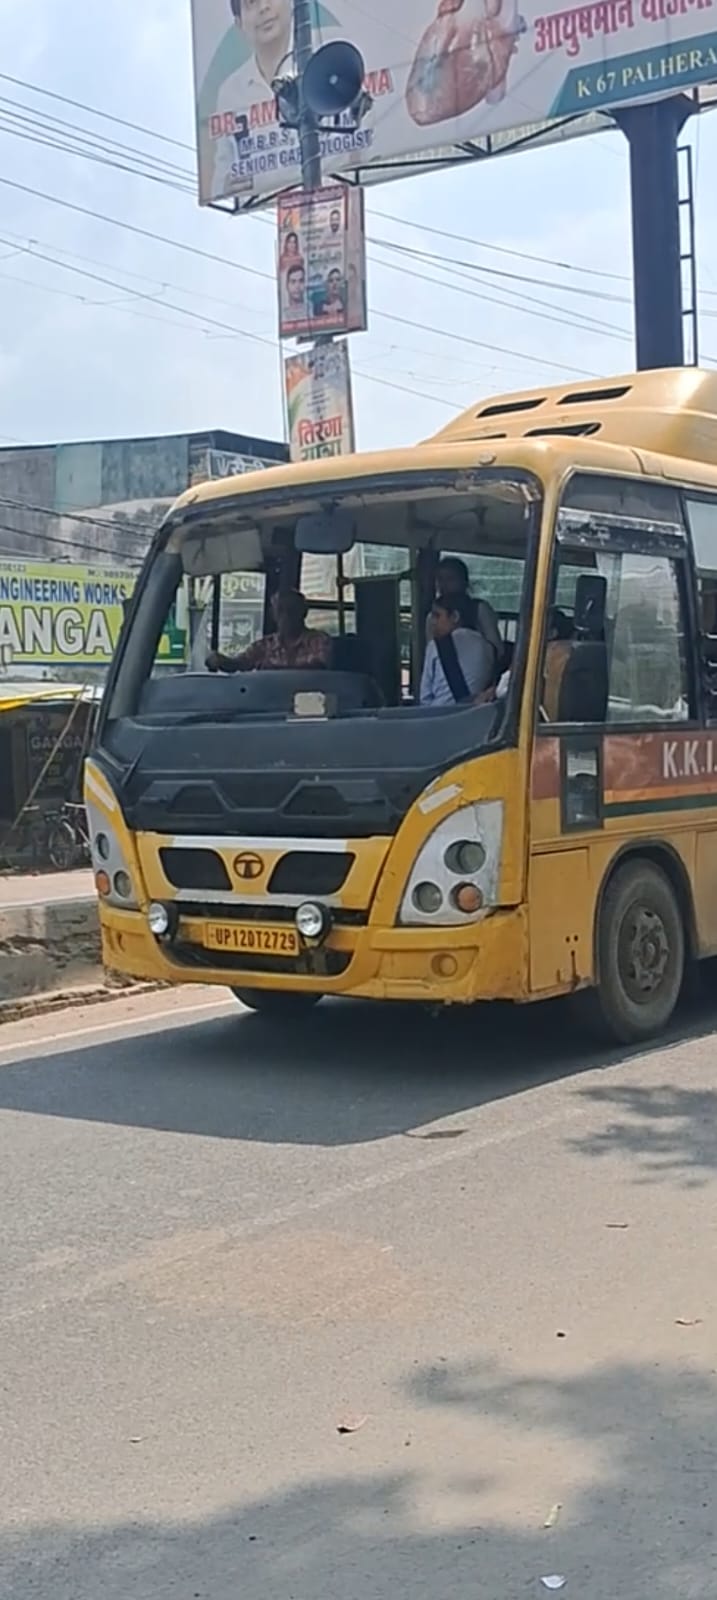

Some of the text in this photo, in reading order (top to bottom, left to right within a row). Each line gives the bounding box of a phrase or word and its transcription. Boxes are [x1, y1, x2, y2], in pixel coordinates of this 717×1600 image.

[577, 47, 717, 98] K 67 PALHERA
[231, 153, 276, 177] SENIOR
[297, 415, 342, 446] तिरंगा
[0, 576, 127, 605] NGINEERING WORKS
[0, 605, 114, 655] ANGA
